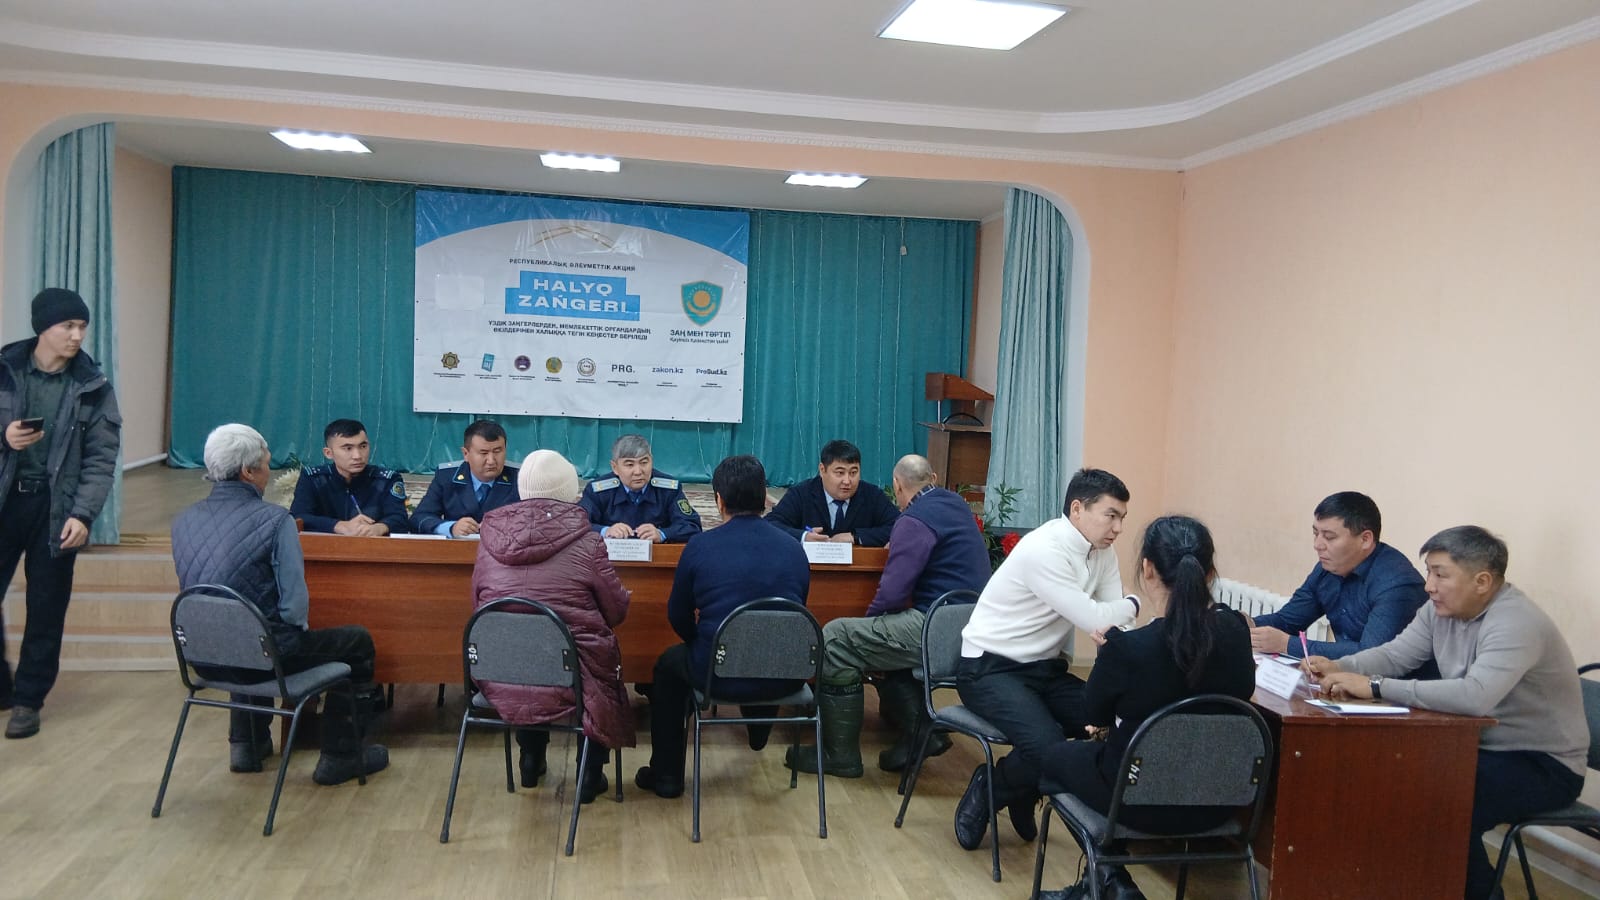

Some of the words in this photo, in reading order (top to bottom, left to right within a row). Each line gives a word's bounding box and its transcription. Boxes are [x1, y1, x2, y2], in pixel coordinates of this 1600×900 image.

[509, 258, 568, 268] РЕСПУБЛИКАЛЫҚ
[533, 278, 613, 297] HALYQ
[670, 329, 686, 337] ЗАҢ
[611, 364, 636, 374] PRG.
[651, 366, 684, 374] zakon.kz
[468, 647, 478, 660] 30
